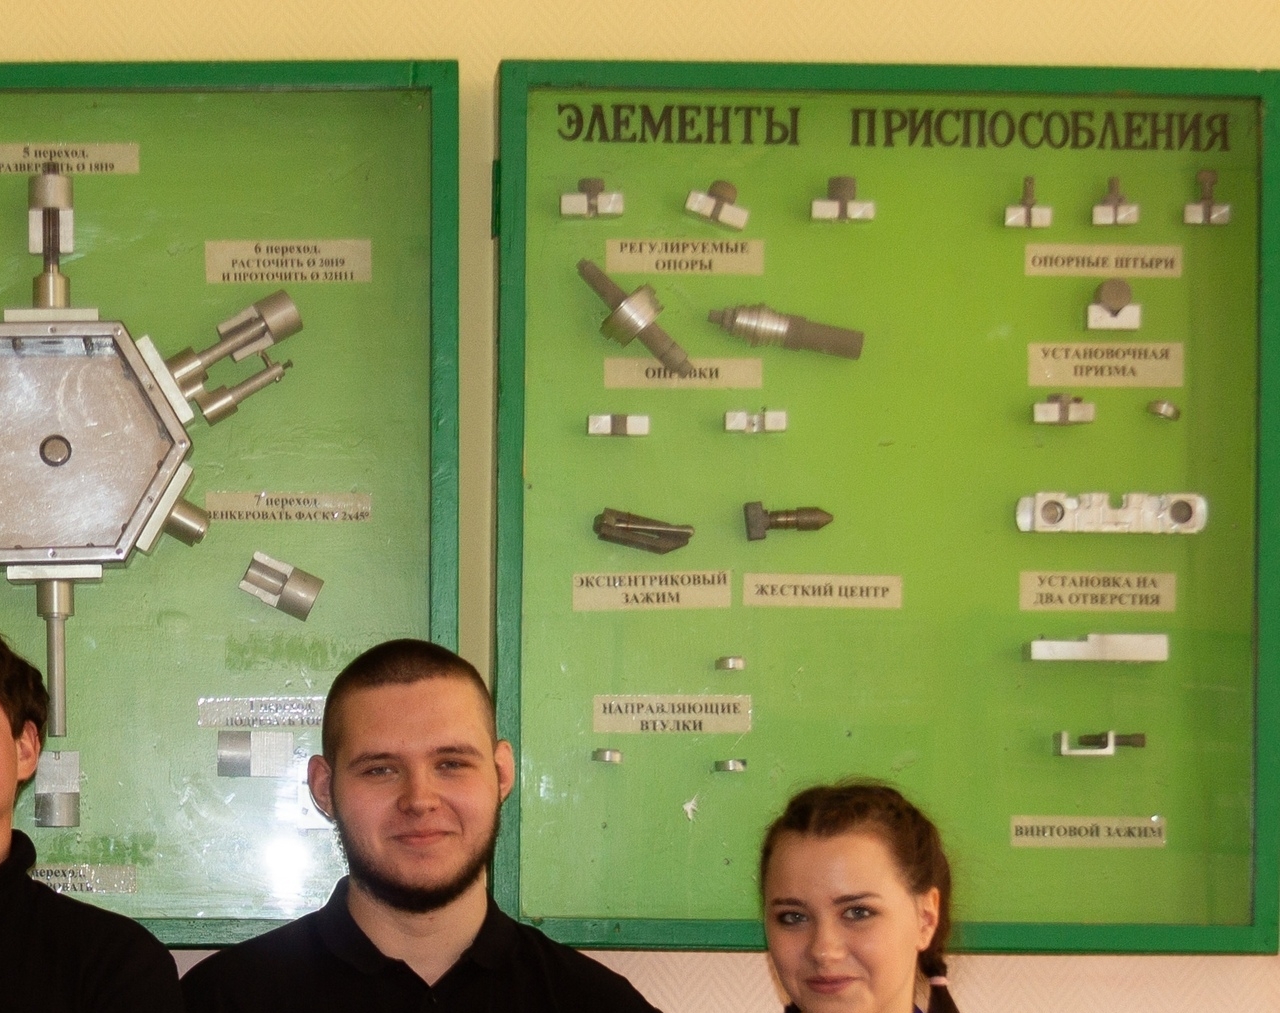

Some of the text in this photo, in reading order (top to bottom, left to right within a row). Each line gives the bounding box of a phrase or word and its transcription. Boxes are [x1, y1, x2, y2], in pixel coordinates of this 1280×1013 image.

[557, 103, 1232, 153] ЭЛЕМЕНТЫ ПРИСПОСОБЛЕНИЯ
[22, 146, 30, 159] 5
[254, 243, 262, 255] 6
[620, 241, 749, 254] РЕГУЛИРУЕМЫЕ
[231, 257, 303, 269] РАСТОЧИТЬ
[655, 259, 713, 272] ОПОРЫ
[1030, 254, 1176, 270] ОПОРНЫЕ ШТЫРИ
[233, 270, 307, 282] ПРОТОЧИТЬ
[1040, 347, 1170, 360] УСТАНОВОЧНАЯ
[1073, 364, 1138, 377] ПРИЗМА
[574, 571, 728, 588] ЭКСЦЕНТРИКОВЫЙ
[1036, 574, 1158, 588] УСТАНОВКА НА
[754, 582, 890, 599] ЖЕСТКИЙ ЦЕНТР
[621, 591, 681, 604] ЗАЖИМ
[1033, 592, 1161, 606] ДВА ОТВЕРСТИЯ
[602, 702, 741, 716] НАПРАВЛЯЮЩИЕ
[640, 719, 703, 732] ВТУЛКИ
[1014, 822, 1163, 838] ВИНТОВОЙ ЗАЖИМ
